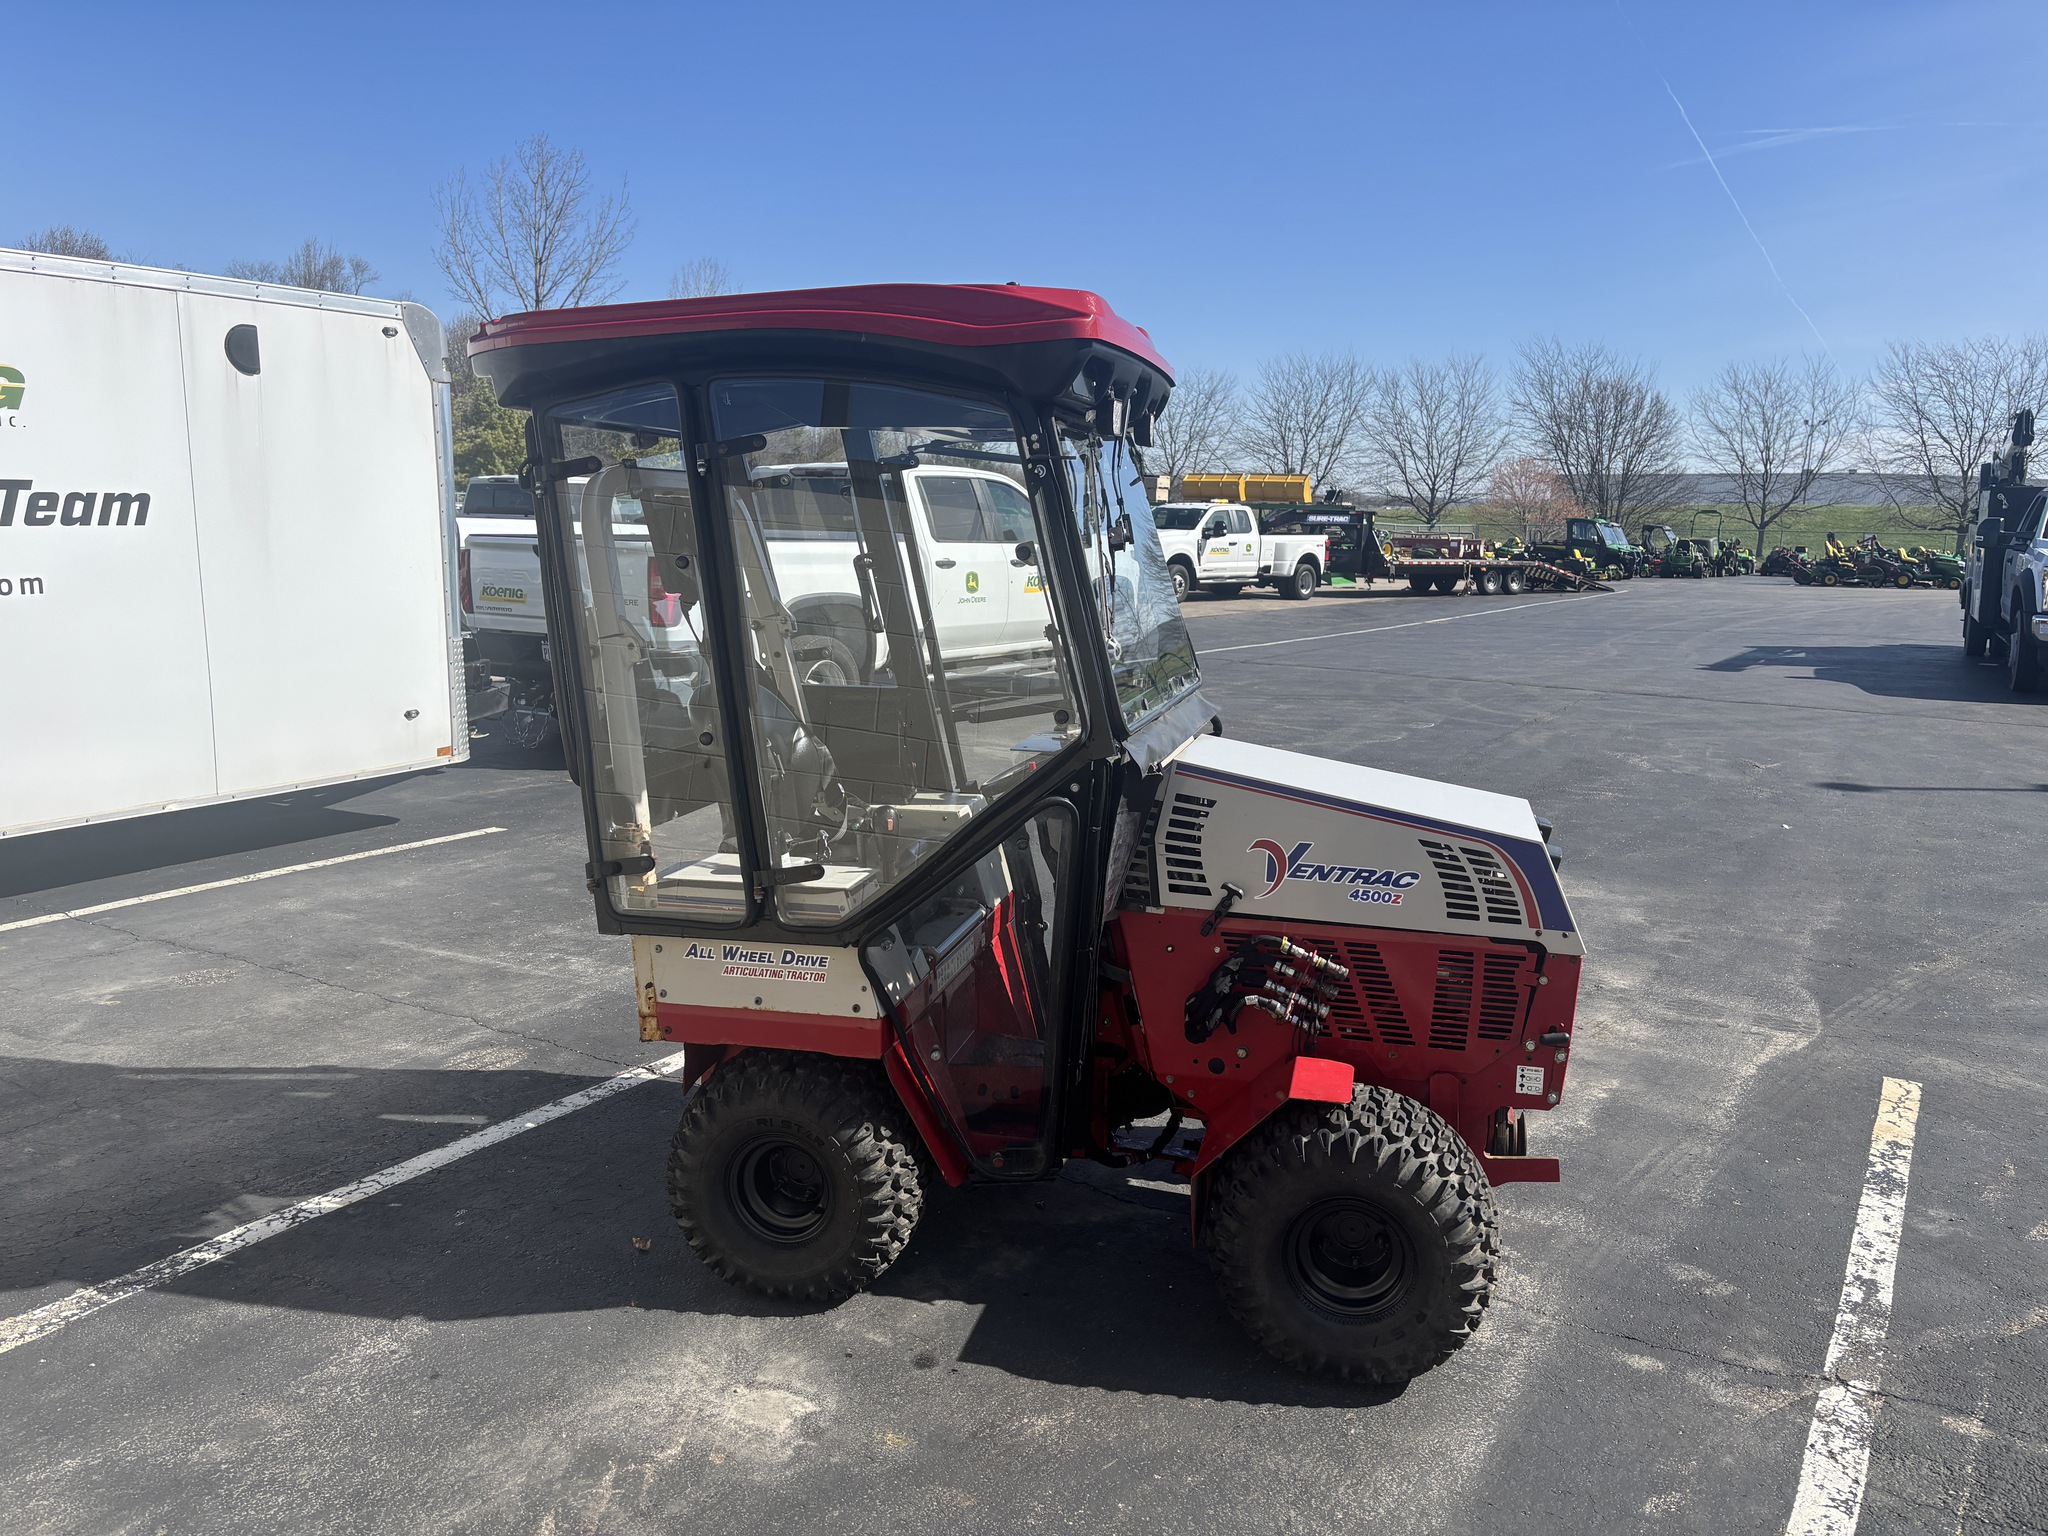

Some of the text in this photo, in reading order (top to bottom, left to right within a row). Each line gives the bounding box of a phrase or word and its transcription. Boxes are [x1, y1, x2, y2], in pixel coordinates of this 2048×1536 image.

[0, 479, 151, 527] Team
[0, 576, 45, 596] om
[1247, 839, 1421, 898] VENTRAC
[1348, 888, 1403, 905] 4500Z
[722, 965, 827, 983] ARTICULATING TRACTOR
